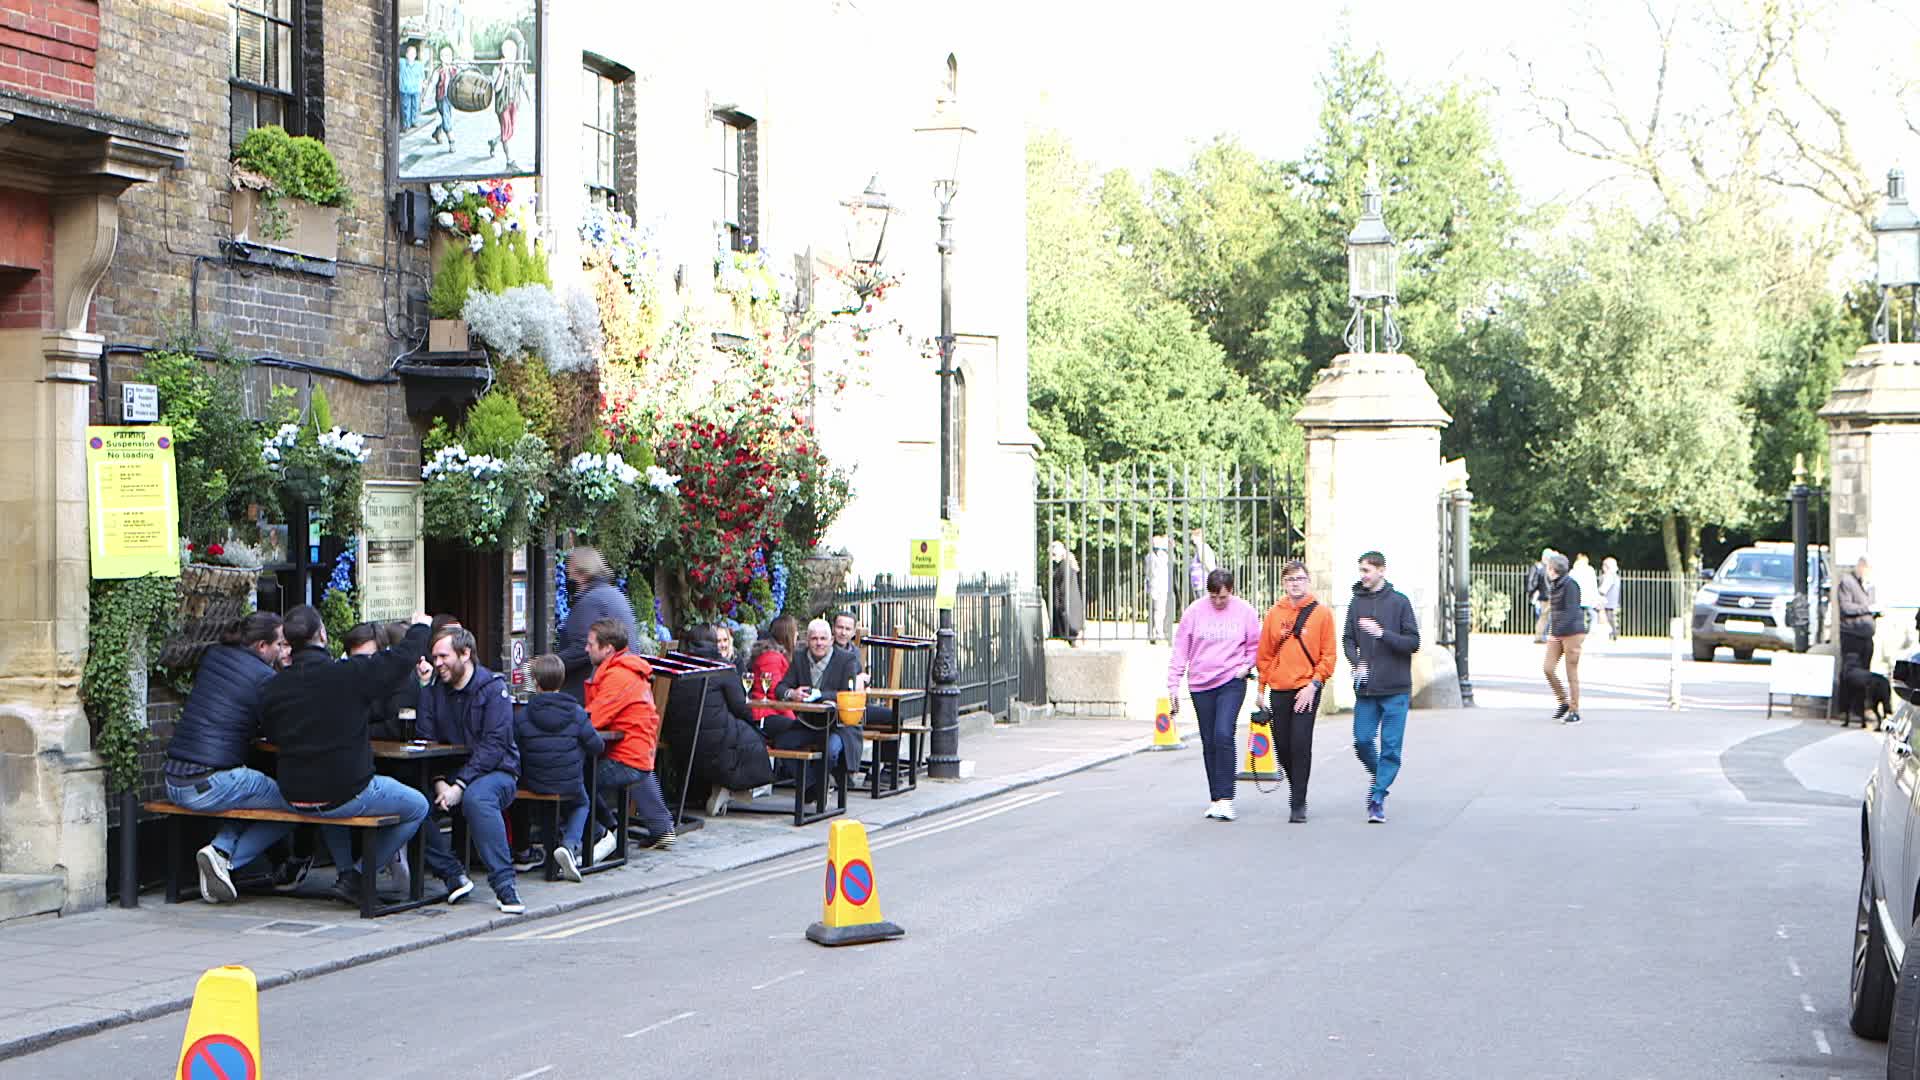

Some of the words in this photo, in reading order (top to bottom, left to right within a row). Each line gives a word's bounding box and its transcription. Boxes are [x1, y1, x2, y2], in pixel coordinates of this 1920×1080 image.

[113, 431, 146, 440] Parking
[106, 440, 155, 449] Suspension
[122, 451, 154, 460] loading
[915, 555, 932, 563] Parking
